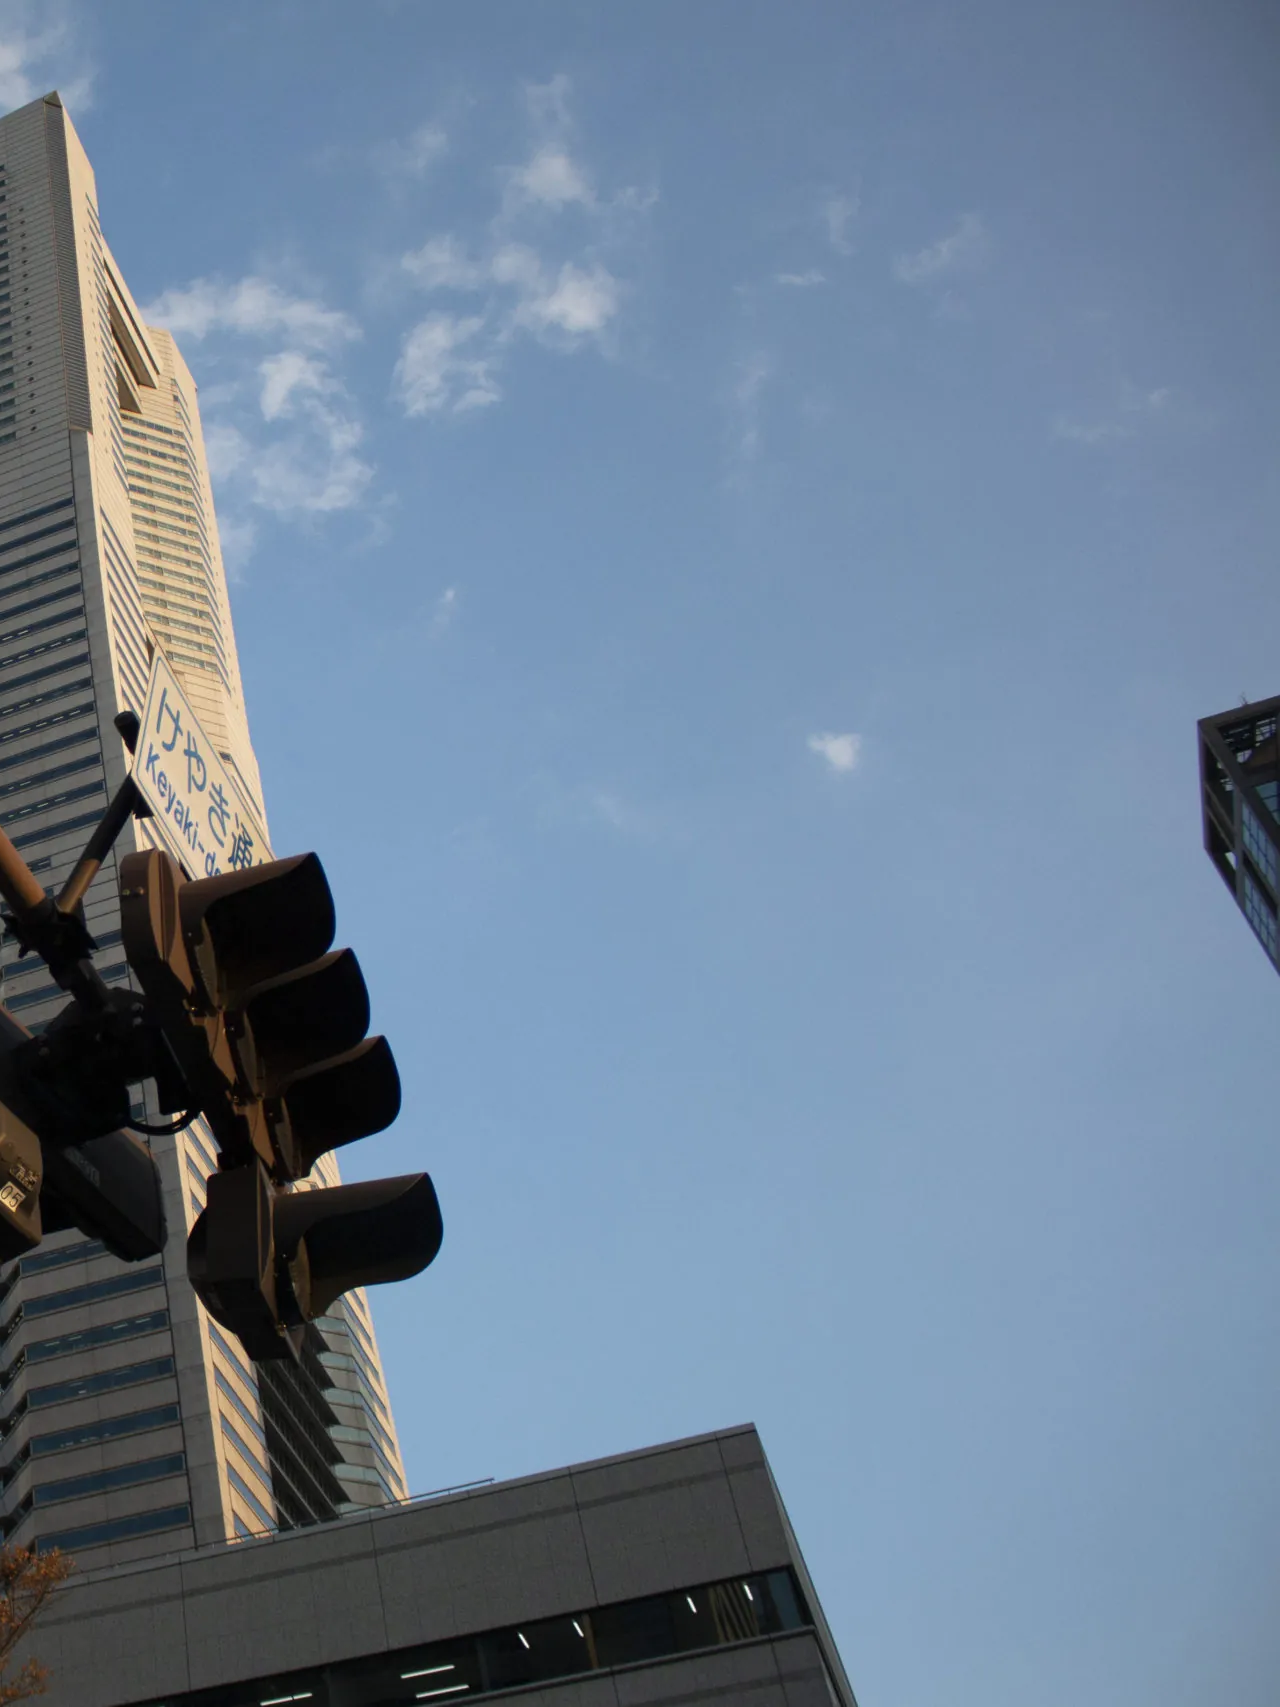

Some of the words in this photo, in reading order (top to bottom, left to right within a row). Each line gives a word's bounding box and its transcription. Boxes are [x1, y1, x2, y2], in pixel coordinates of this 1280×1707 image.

[156, 687, 264, 871] けやき通
[0, 1185, 23, 1208] 05
